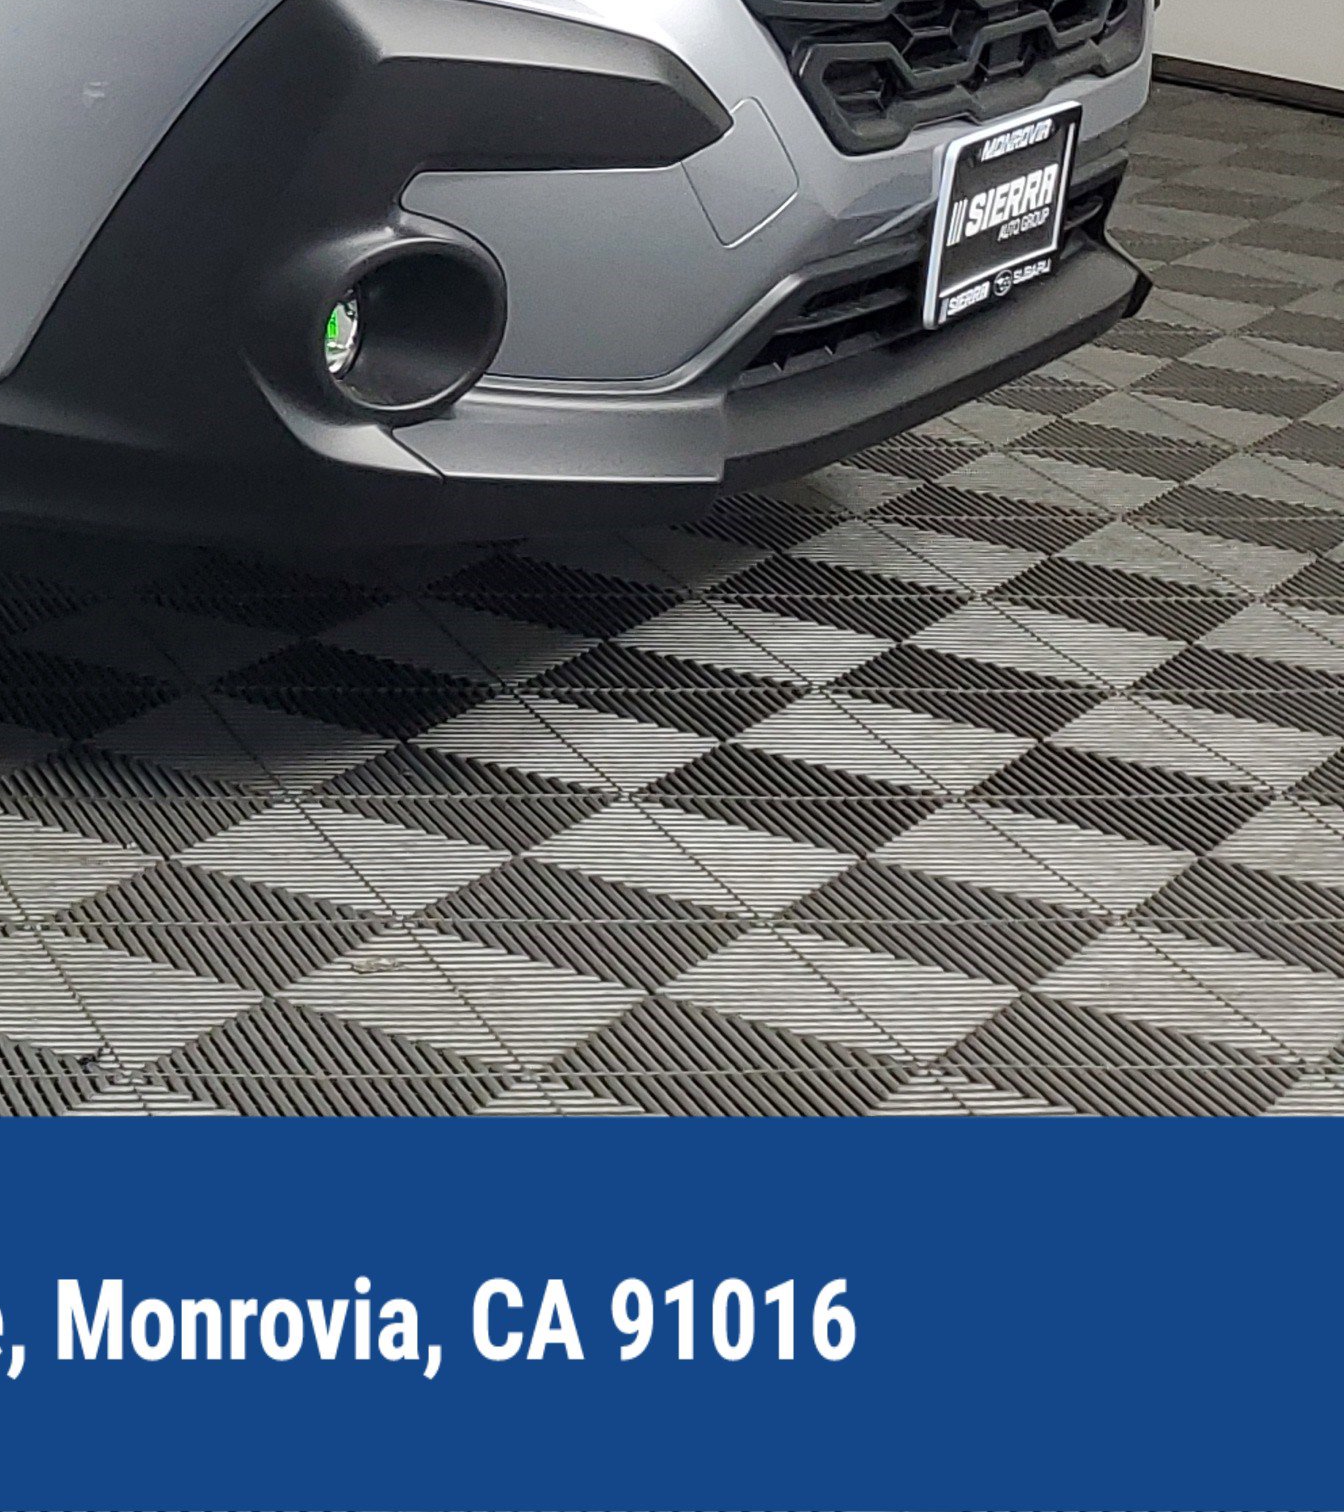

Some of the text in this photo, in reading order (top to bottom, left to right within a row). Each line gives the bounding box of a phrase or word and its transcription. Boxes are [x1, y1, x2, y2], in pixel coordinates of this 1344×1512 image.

[981, 118, 1053, 162] MONROVIA
[964, 163, 1059, 237] SIERRA
[997, 207, 1050, 242] AUTO GROUP
